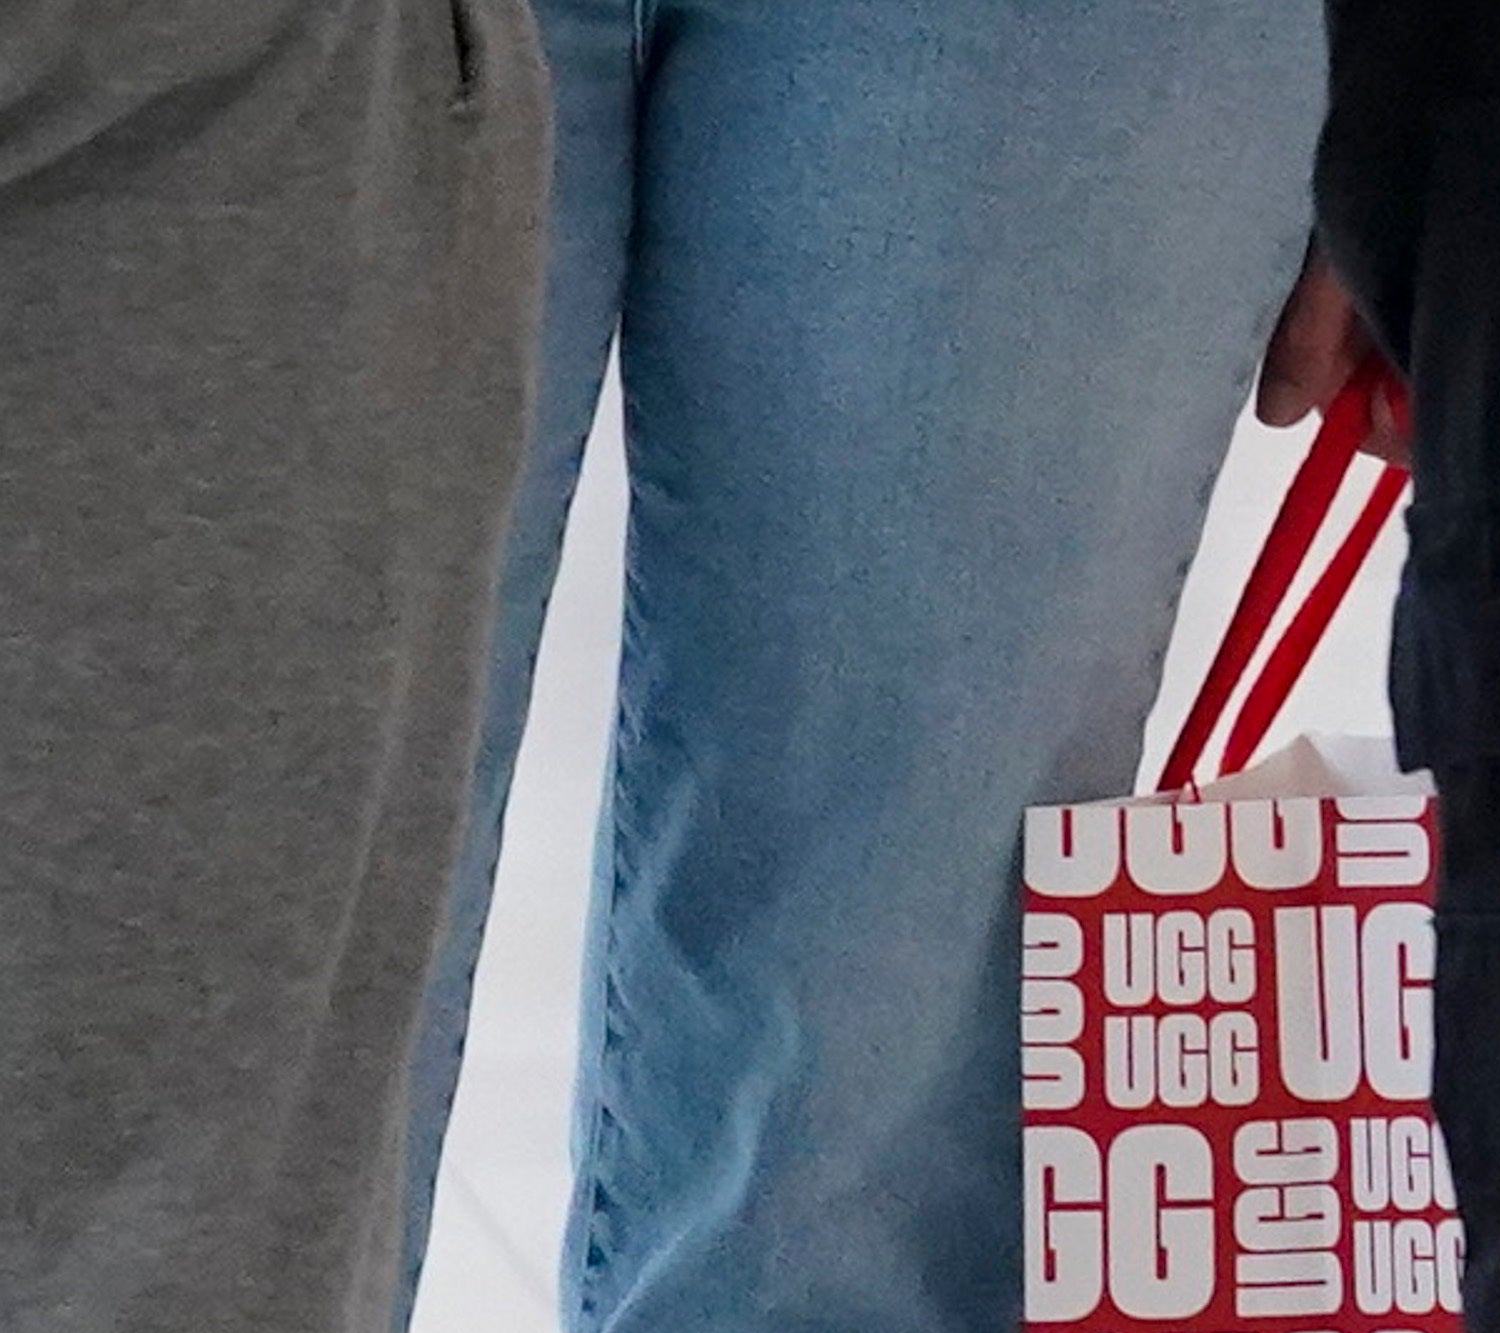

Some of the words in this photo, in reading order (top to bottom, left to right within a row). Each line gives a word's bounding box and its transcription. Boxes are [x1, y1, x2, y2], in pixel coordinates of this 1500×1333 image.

[1104, 908, 1257, 1007] UGG
[1272, 902, 1437, 1101] UG
[1104, 1011, 1260, 1108] UGG
[1023, 1123, 1215, 1322] GG
[1232, 1117, 1344, 1319] UGG
